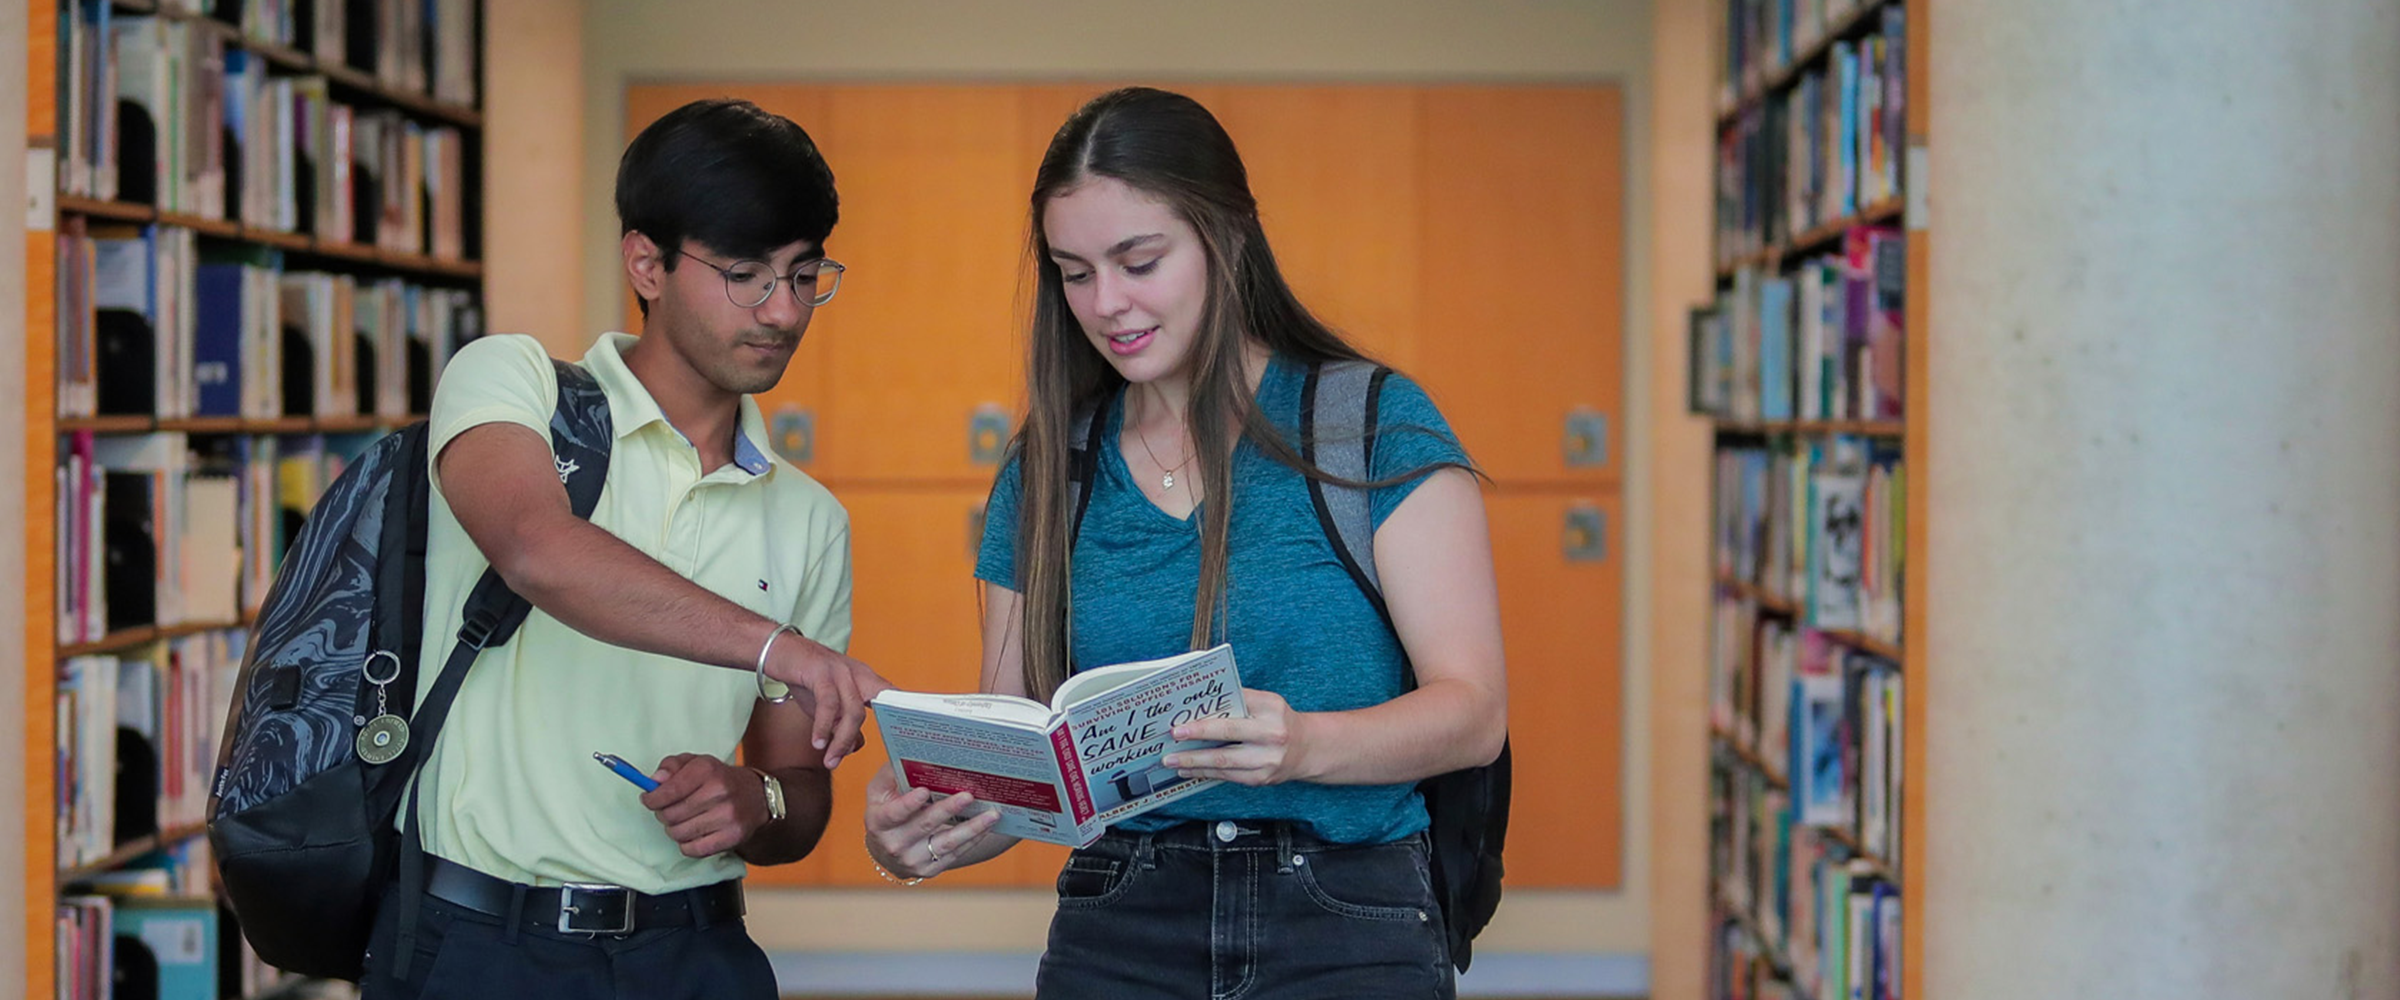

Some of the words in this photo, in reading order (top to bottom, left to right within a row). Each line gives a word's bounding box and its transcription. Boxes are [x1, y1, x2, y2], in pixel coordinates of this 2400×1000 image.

[1071, 705, 1131, 731] SURVIVING
[1134, 688, 1172, 707] OFFICE
[1176, 668, 1227, 691] INSANITY
[1080, 722, 1117, 745] Am
[1127, 710, 1136, 727] I
[1144, 702, 1175, 719] the
[1183, 679, 1224, 706] only
[1095, 705, 1113, 715] 101
[1117, 681, 1176, 708] SOLUTIONS
[1179, 671, 1200, 684] FOR
[1082, 721, 1158, 761] SANE
[1170, 691, 1233, 729] ONE
[1090, 742, 1164, 775] working
[1099, 802, 1140, 820] ALBERT
